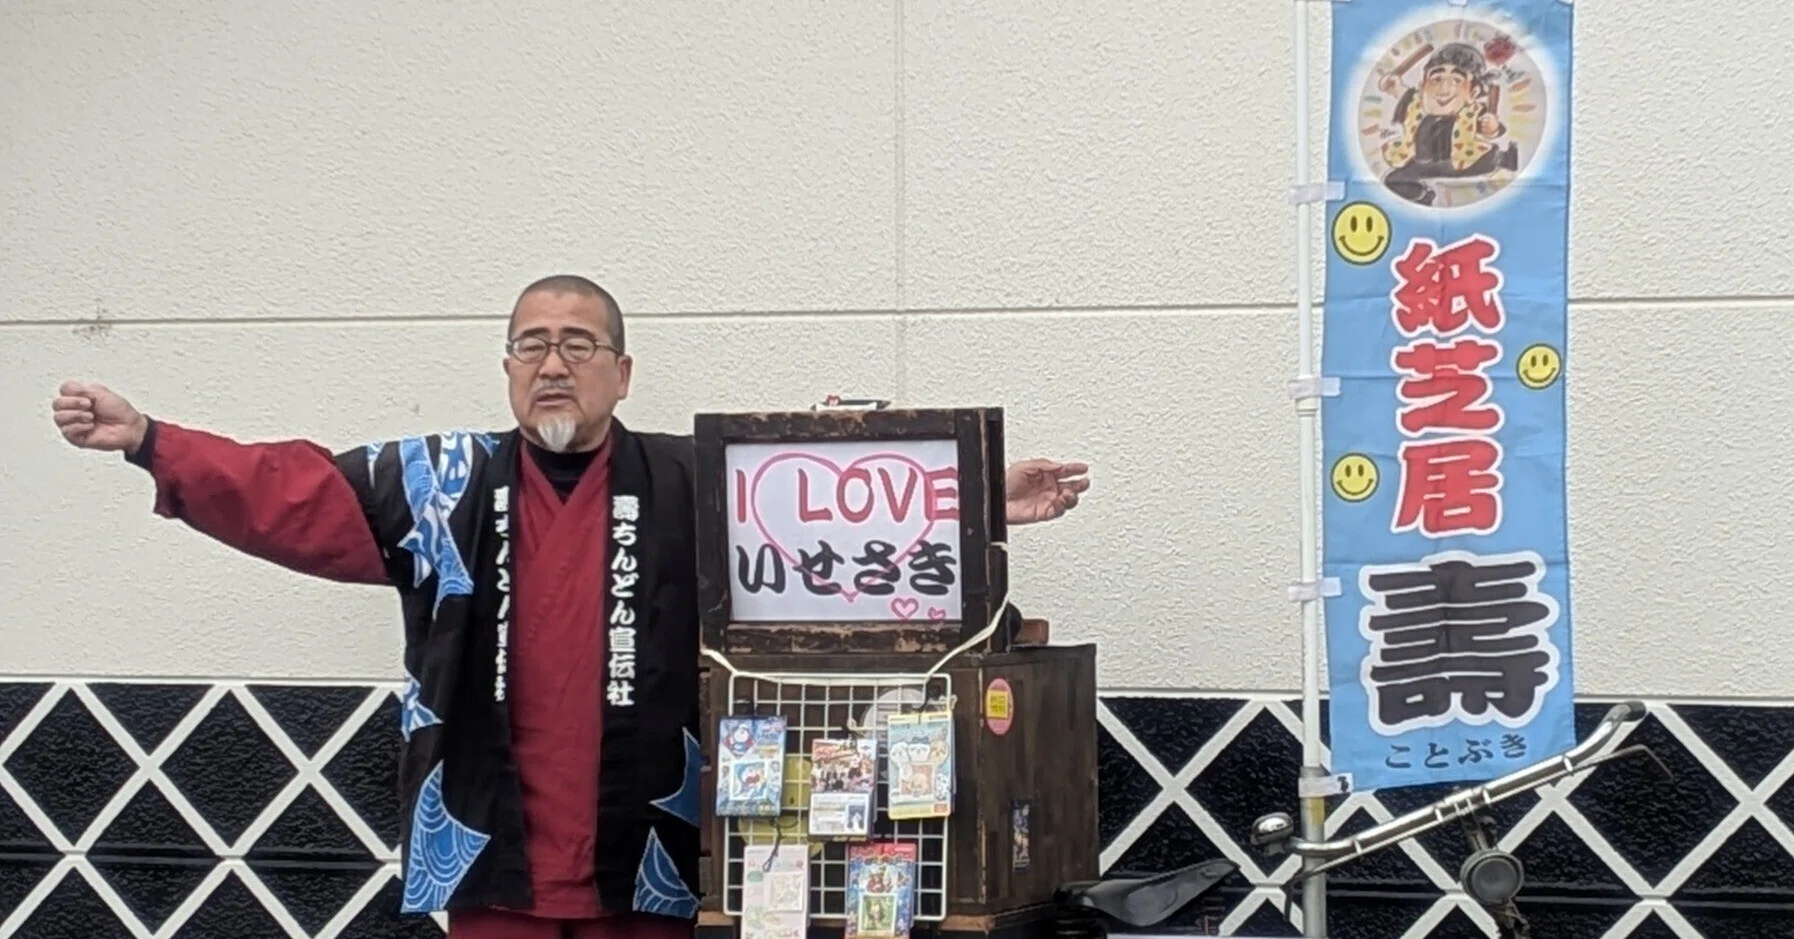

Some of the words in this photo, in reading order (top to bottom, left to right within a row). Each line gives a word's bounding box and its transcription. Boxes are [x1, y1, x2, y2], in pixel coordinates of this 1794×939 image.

[1393, 237, 1502, 535] 紙芝居
[735, 468, 747, 524] I
[797, 466, 960, 524] LOVE
[736, 539, 957, 596] いせさき
[1385, 733, 1528, 770] ことぶき
